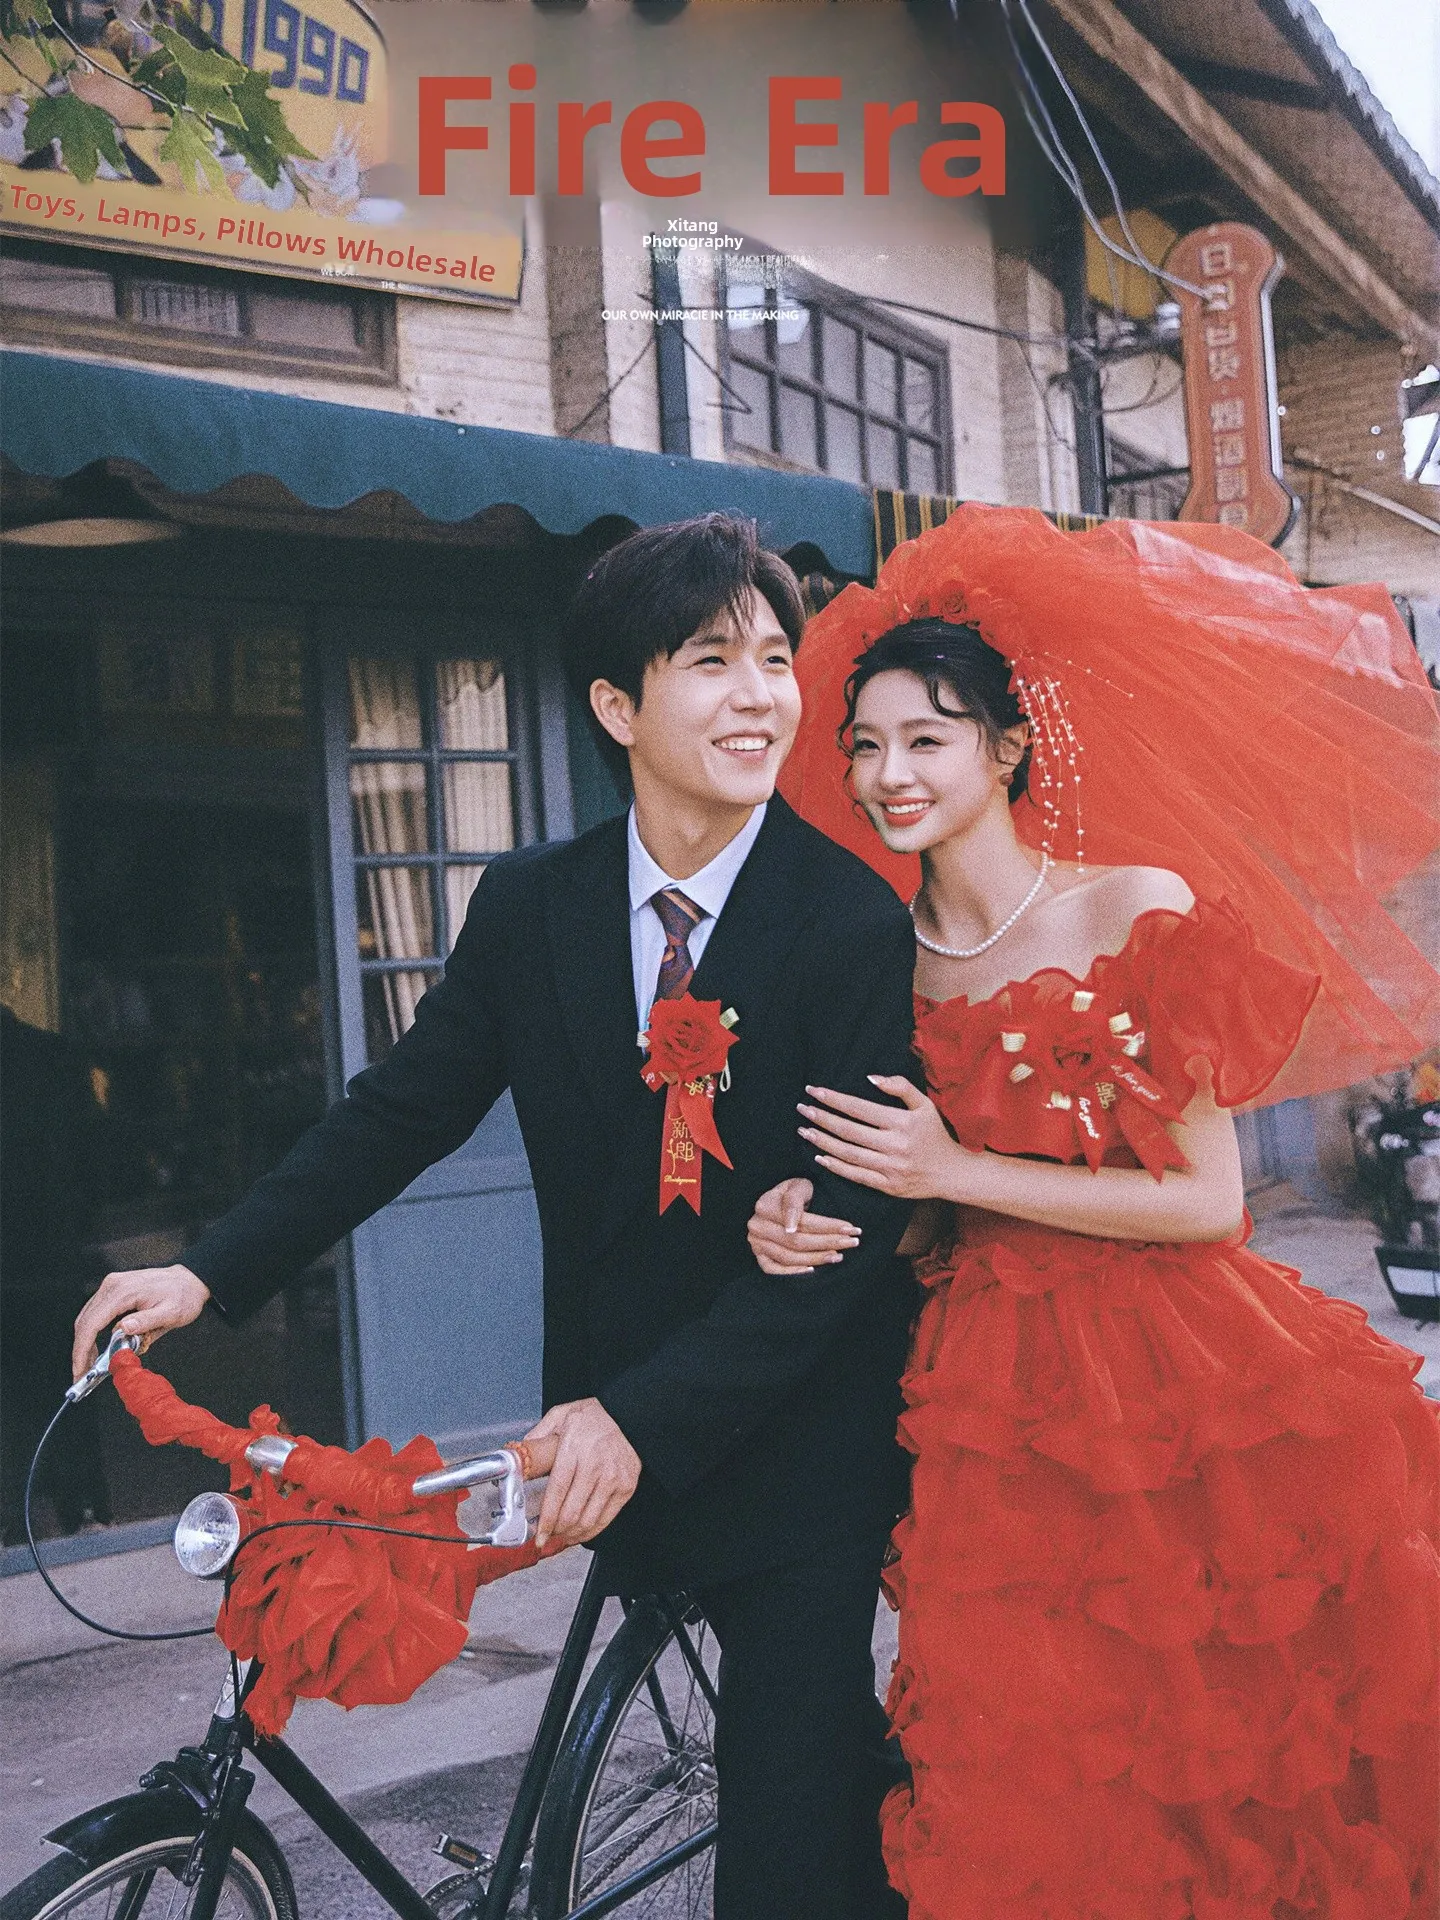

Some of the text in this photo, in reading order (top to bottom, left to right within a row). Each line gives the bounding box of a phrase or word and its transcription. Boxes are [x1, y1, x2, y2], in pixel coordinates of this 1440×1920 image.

[241, 0, 369, 103] 1990
[10, 185, 497, 283] Toys, Lamps, Pillows Wholesale
[671, 1120, 695, 1162] 新郎
